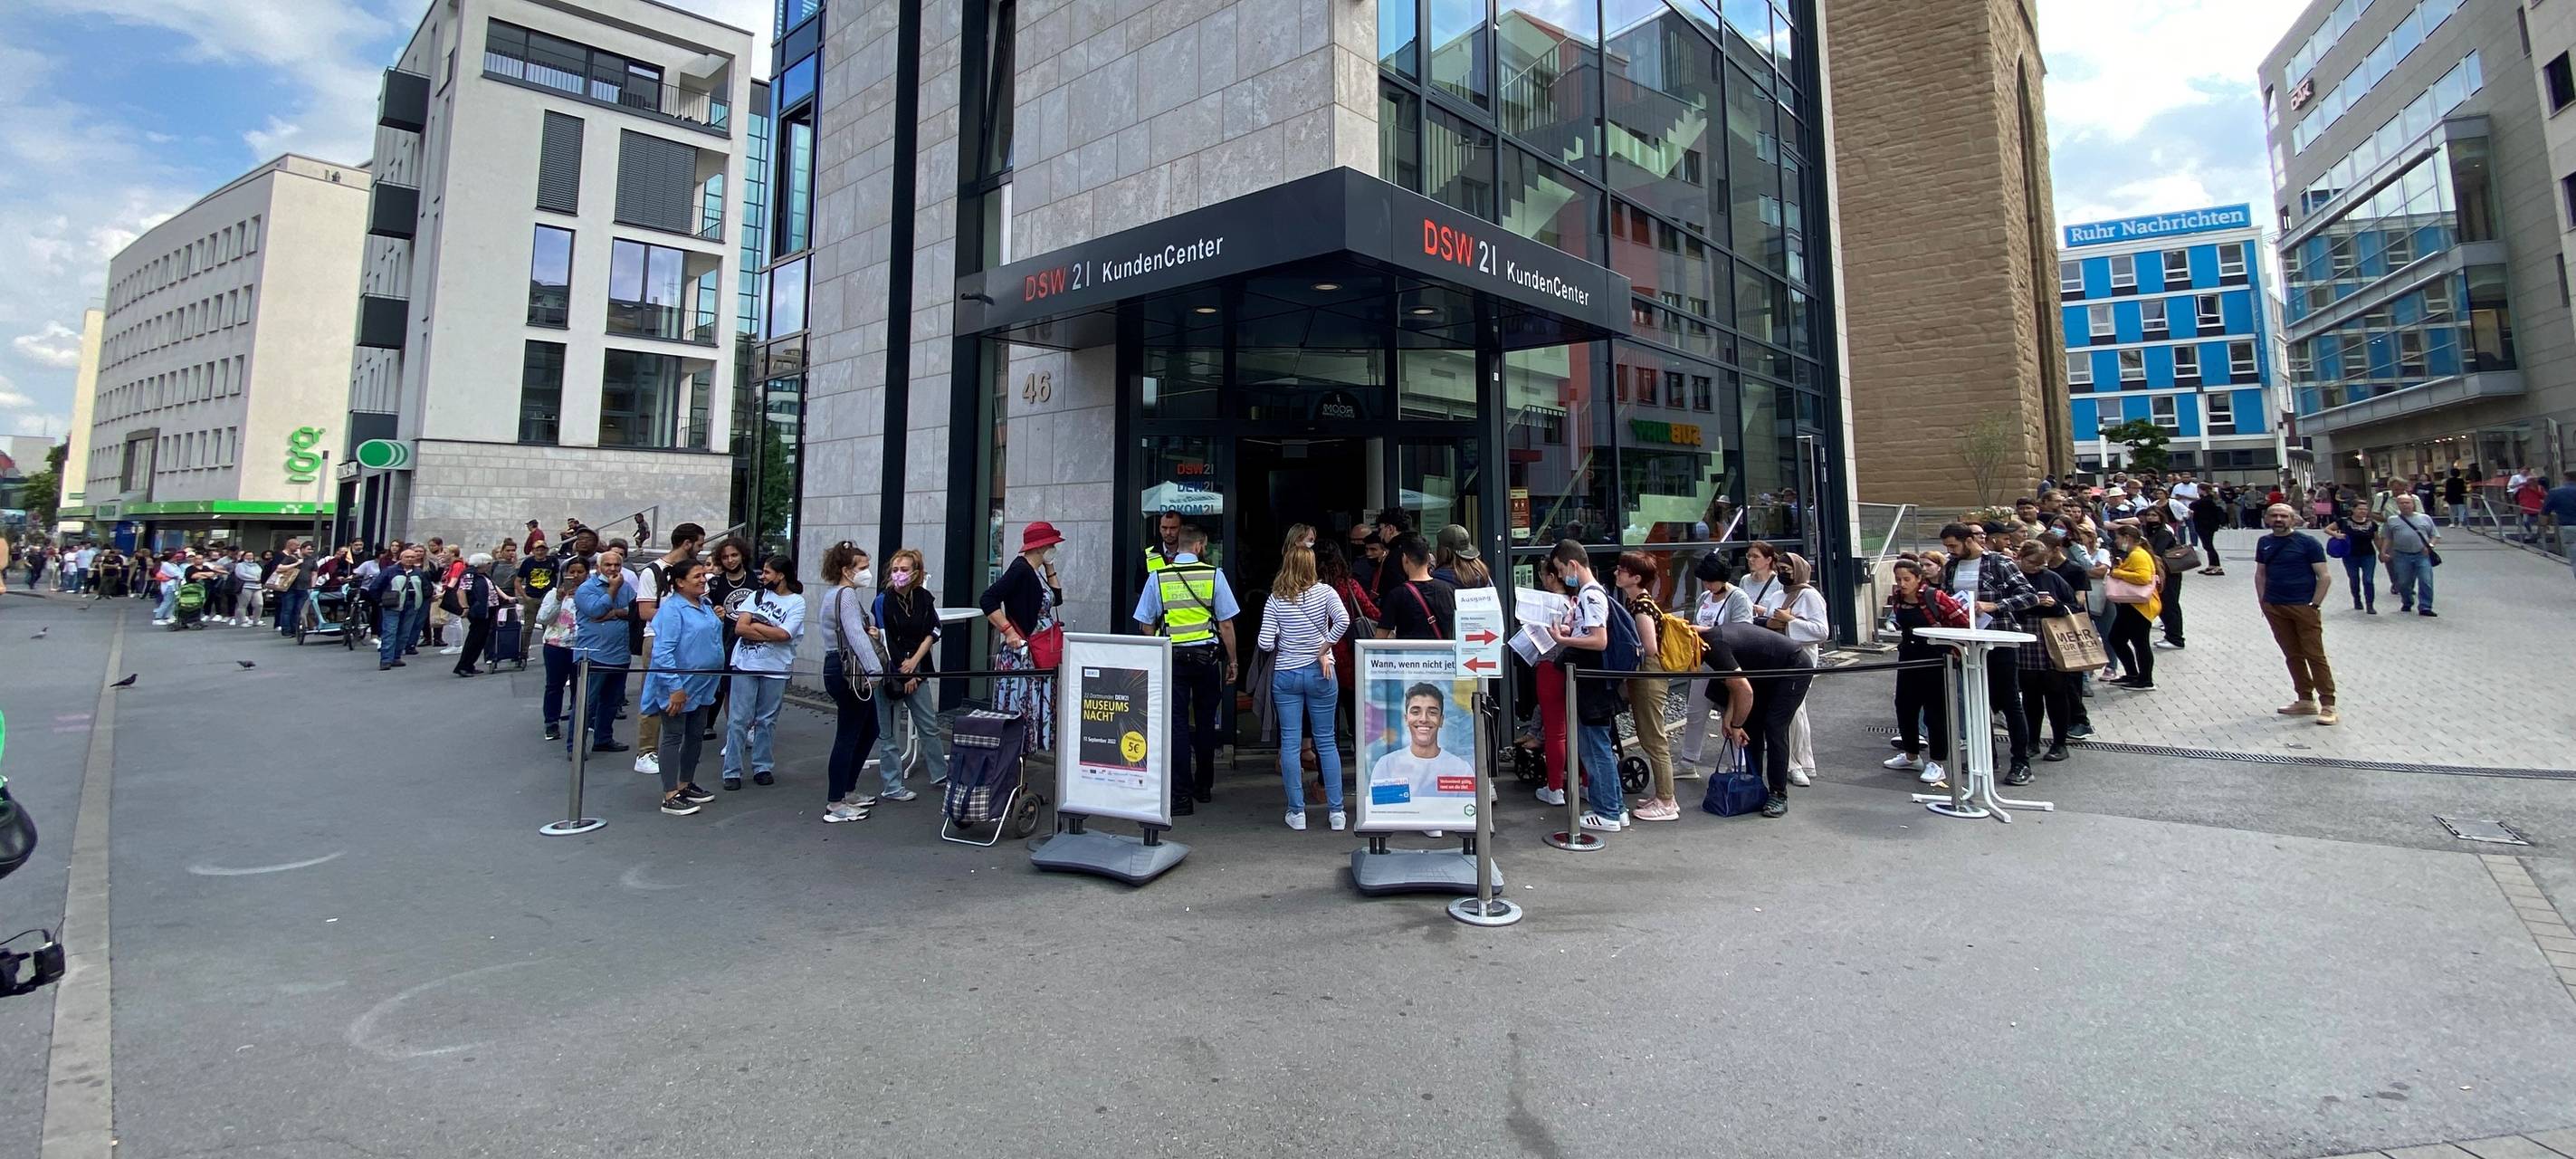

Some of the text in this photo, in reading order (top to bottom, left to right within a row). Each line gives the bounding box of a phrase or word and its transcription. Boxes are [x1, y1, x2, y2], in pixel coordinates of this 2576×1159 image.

[2071, 209, 2246, 242] Ruhr Nachrichten
[1422, 216, 1474, 267] DSW
[1506, 260, 1589, 306] KundenCenter
[1024, 266, 1067, 302] DSW
[1102, 236, 1224, 283] KundenCenter
[1022, 370, 1051, 405] 46
[2056, 629, 2094, 642] MEHR
[1370, 659, 1397, 669] Wann,
[1422, 659, 1443, 669] nicht
[1444, 660, 1455, 671] jet
[1083, 699, 1130, 713] MUSEUMS
[1083, 710, 1115, 722] NACHT
[1128, 742, 1140, 753] 5€
